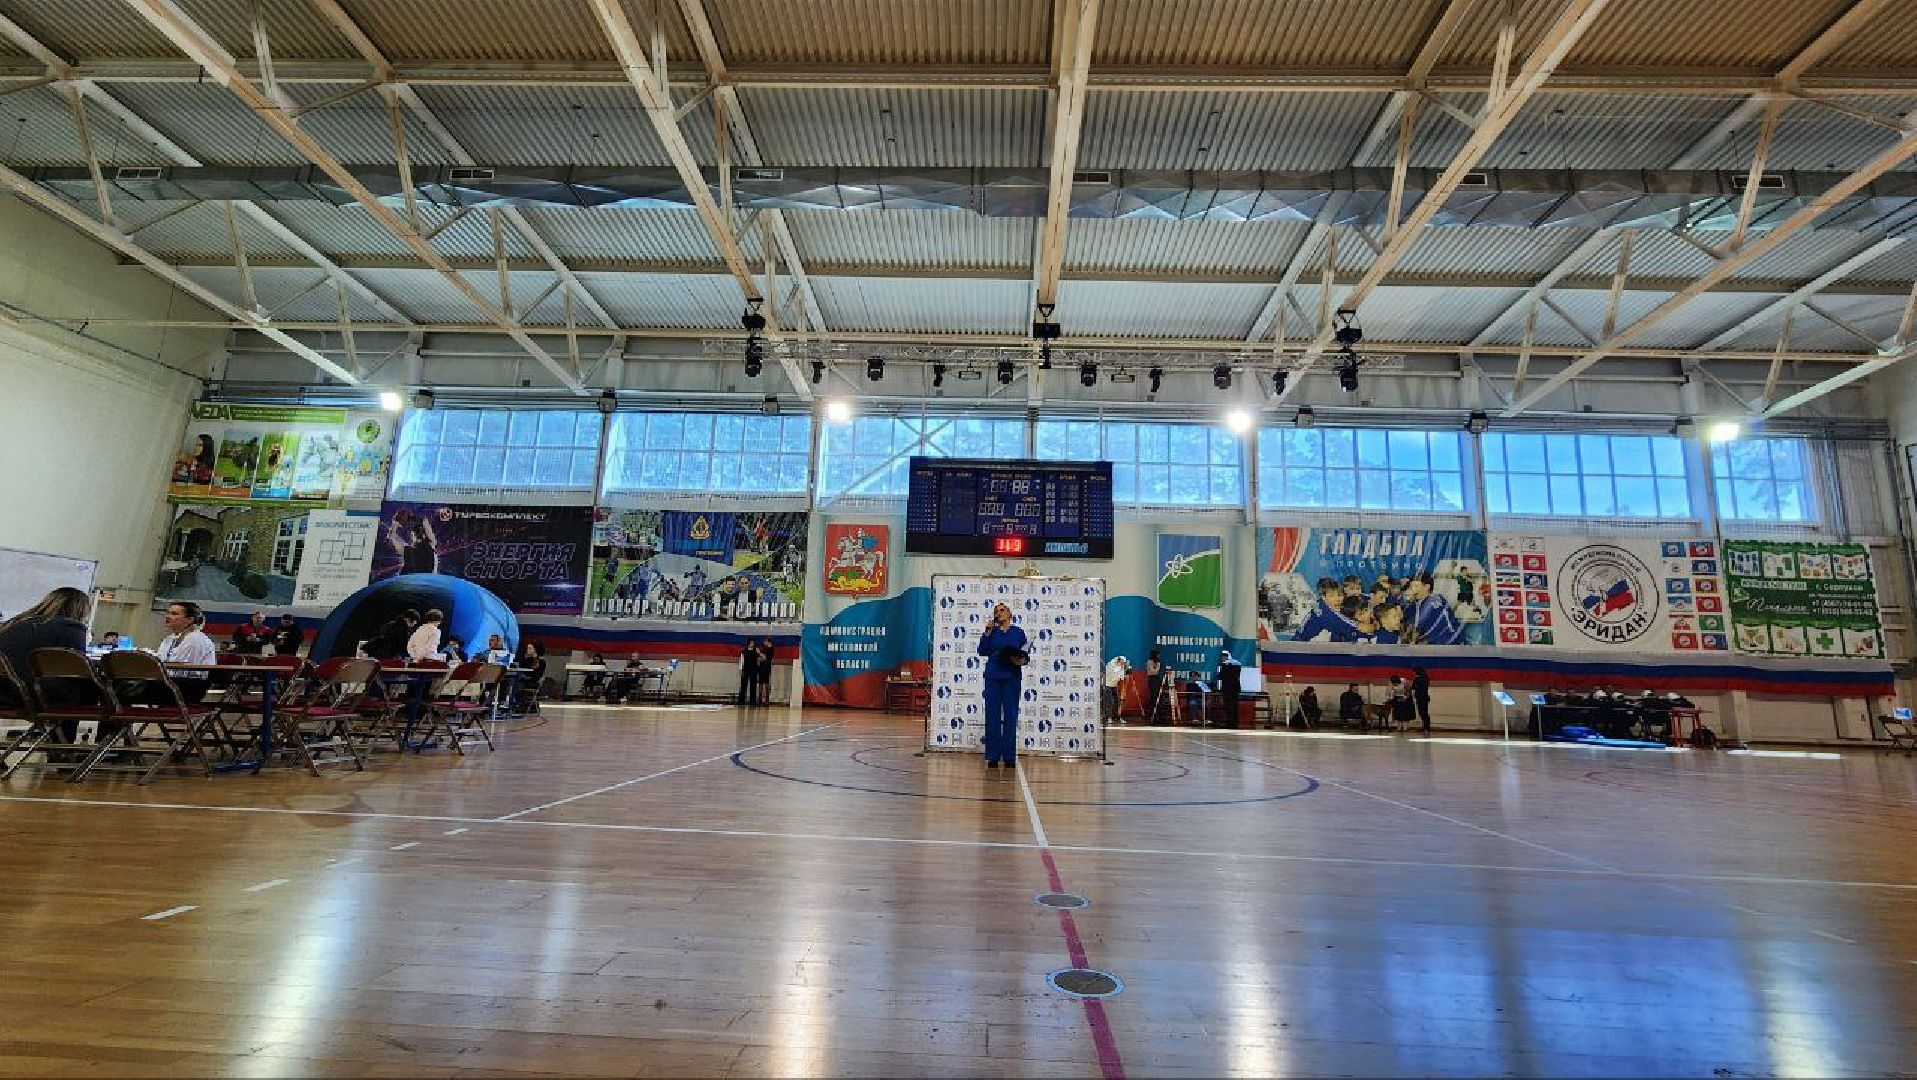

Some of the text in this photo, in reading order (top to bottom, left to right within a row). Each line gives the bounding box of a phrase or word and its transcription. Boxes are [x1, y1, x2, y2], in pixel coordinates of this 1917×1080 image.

[471, 541, 577, 561] ЭНЕРГИЯ
[1320, 533, 1424, 559] ГАНДБОЛ
[464, 560, 571, 580] СПОРТА
[1336, 561, 1423, 570] ПРОТВИНО
[593, 599, 649, 615] СПОНСОР
[656, 600, 707, 616] СПОРТА
[728, 602, 797, 618] ПРОТВИНО
[1572, 610, 1647, 641] ЭРИДАН
[827, 642, 878, 652] МОСКОВСКОЙ
[1156, 636, 1223, 647] АДМИНИСТРАЦИЯ
[836, 659, 870, 669] ОБЛАСТИ
[1176, 653, 1205, 663] ГОРОДА
